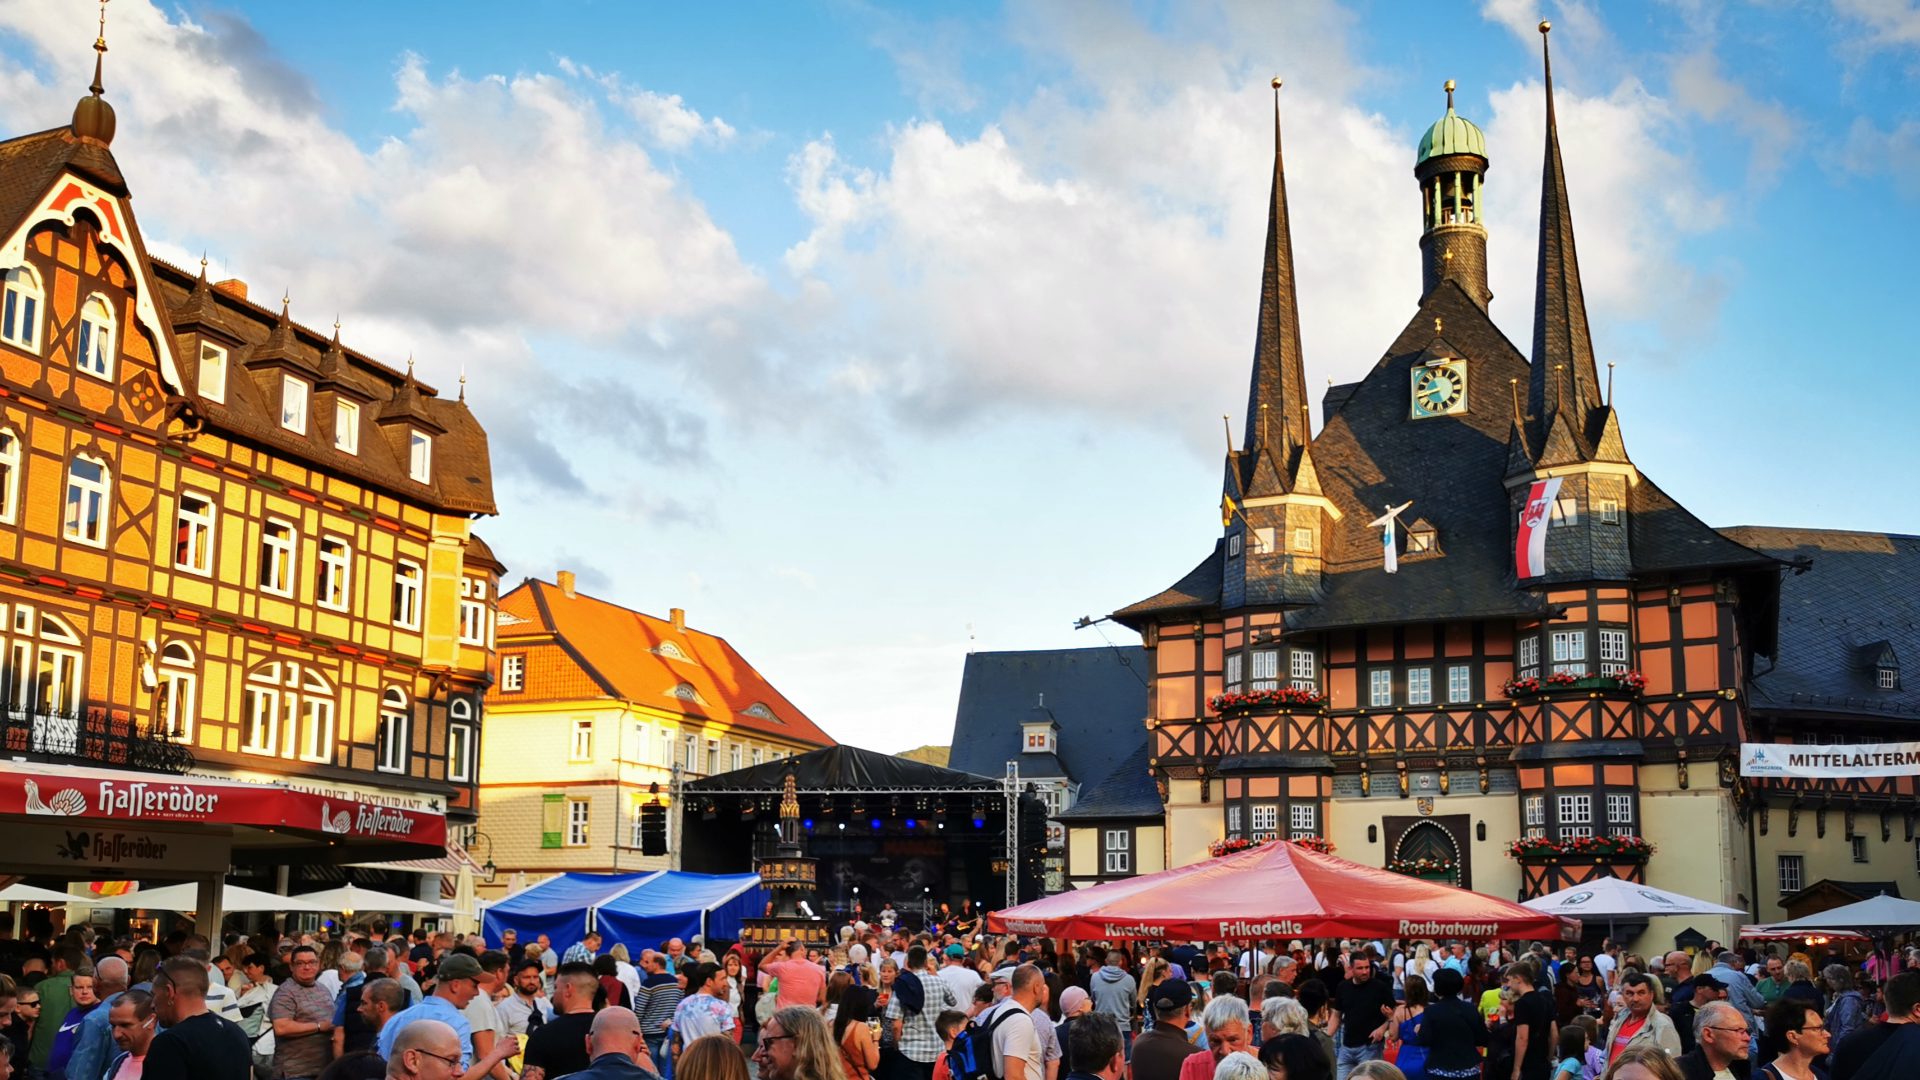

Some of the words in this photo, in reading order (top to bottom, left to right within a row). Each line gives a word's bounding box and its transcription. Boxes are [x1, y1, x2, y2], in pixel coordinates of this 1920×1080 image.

[1105, 922, 1165, 937] Knacker
[1219, 920, 1302, 938] Frikadelle
[1398, 919, 1499, 936] Rostbratwurst
